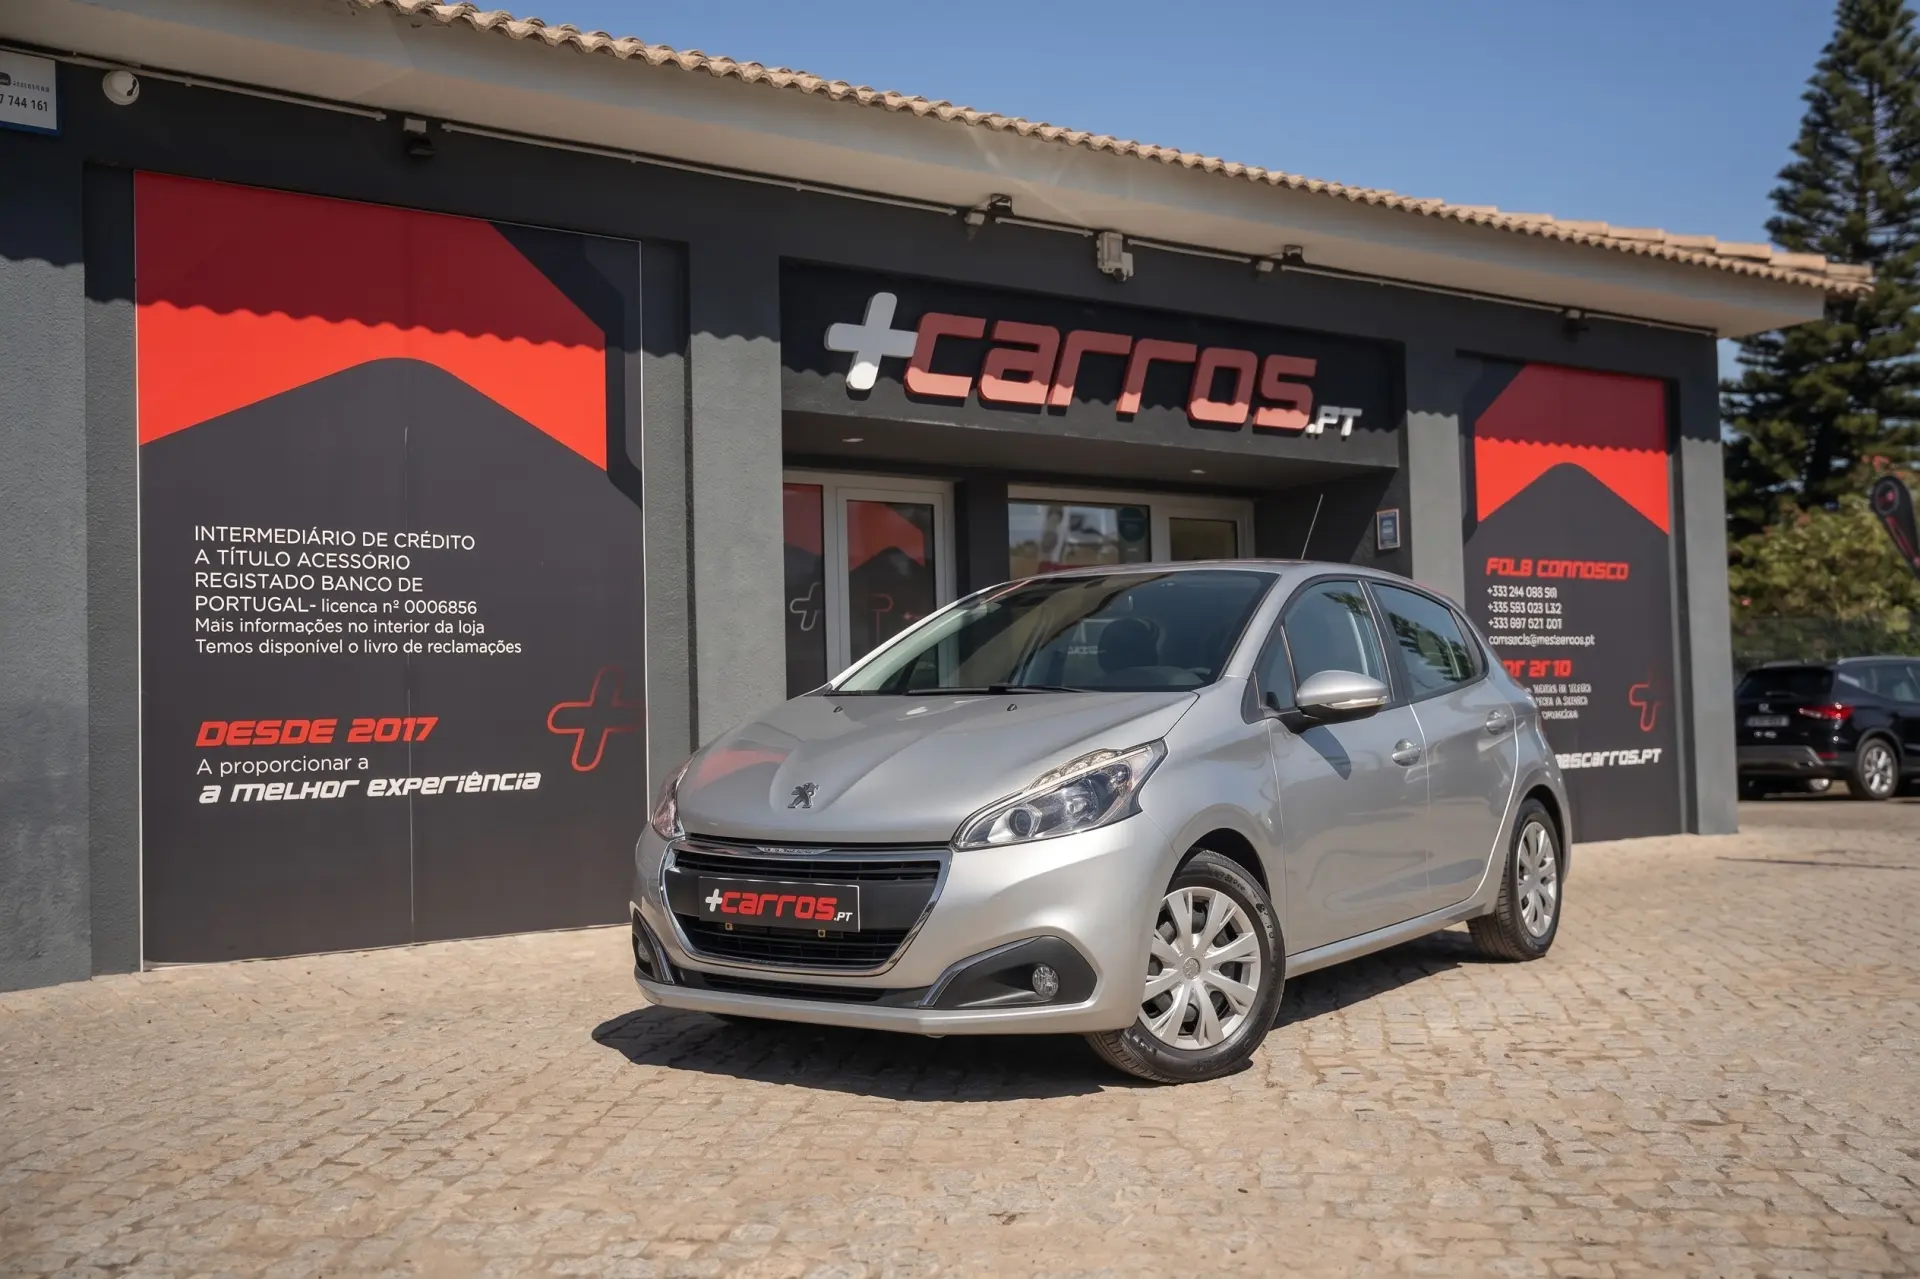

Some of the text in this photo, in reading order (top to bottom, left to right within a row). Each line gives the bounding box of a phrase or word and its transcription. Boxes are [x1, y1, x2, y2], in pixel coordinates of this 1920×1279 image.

[8, 94, 28, 109] 744
[31, 99, 48, 112] 161
[195, 526, 475, 550] INTERMEDIÁRIO DE CRÉDITO
[195, 547, 410, 570] A TÍTULO ACESSÓRIO
[196, 572, 423, 592] REGISTADO BANCO DE
[196, 596, 316, 612] PORTUGAL-
[405, 600, 477, 614] 0006856
[196, 618, 484, 636] Mais informações no interior da loja
[195, 639, 521, 656] Temos disponível o livro de reclamações
[196, 716, 438, 747] DESDE 2017
[197, 756, 368, 777] A proporcionar a
[199, 785, 221, 803] a
